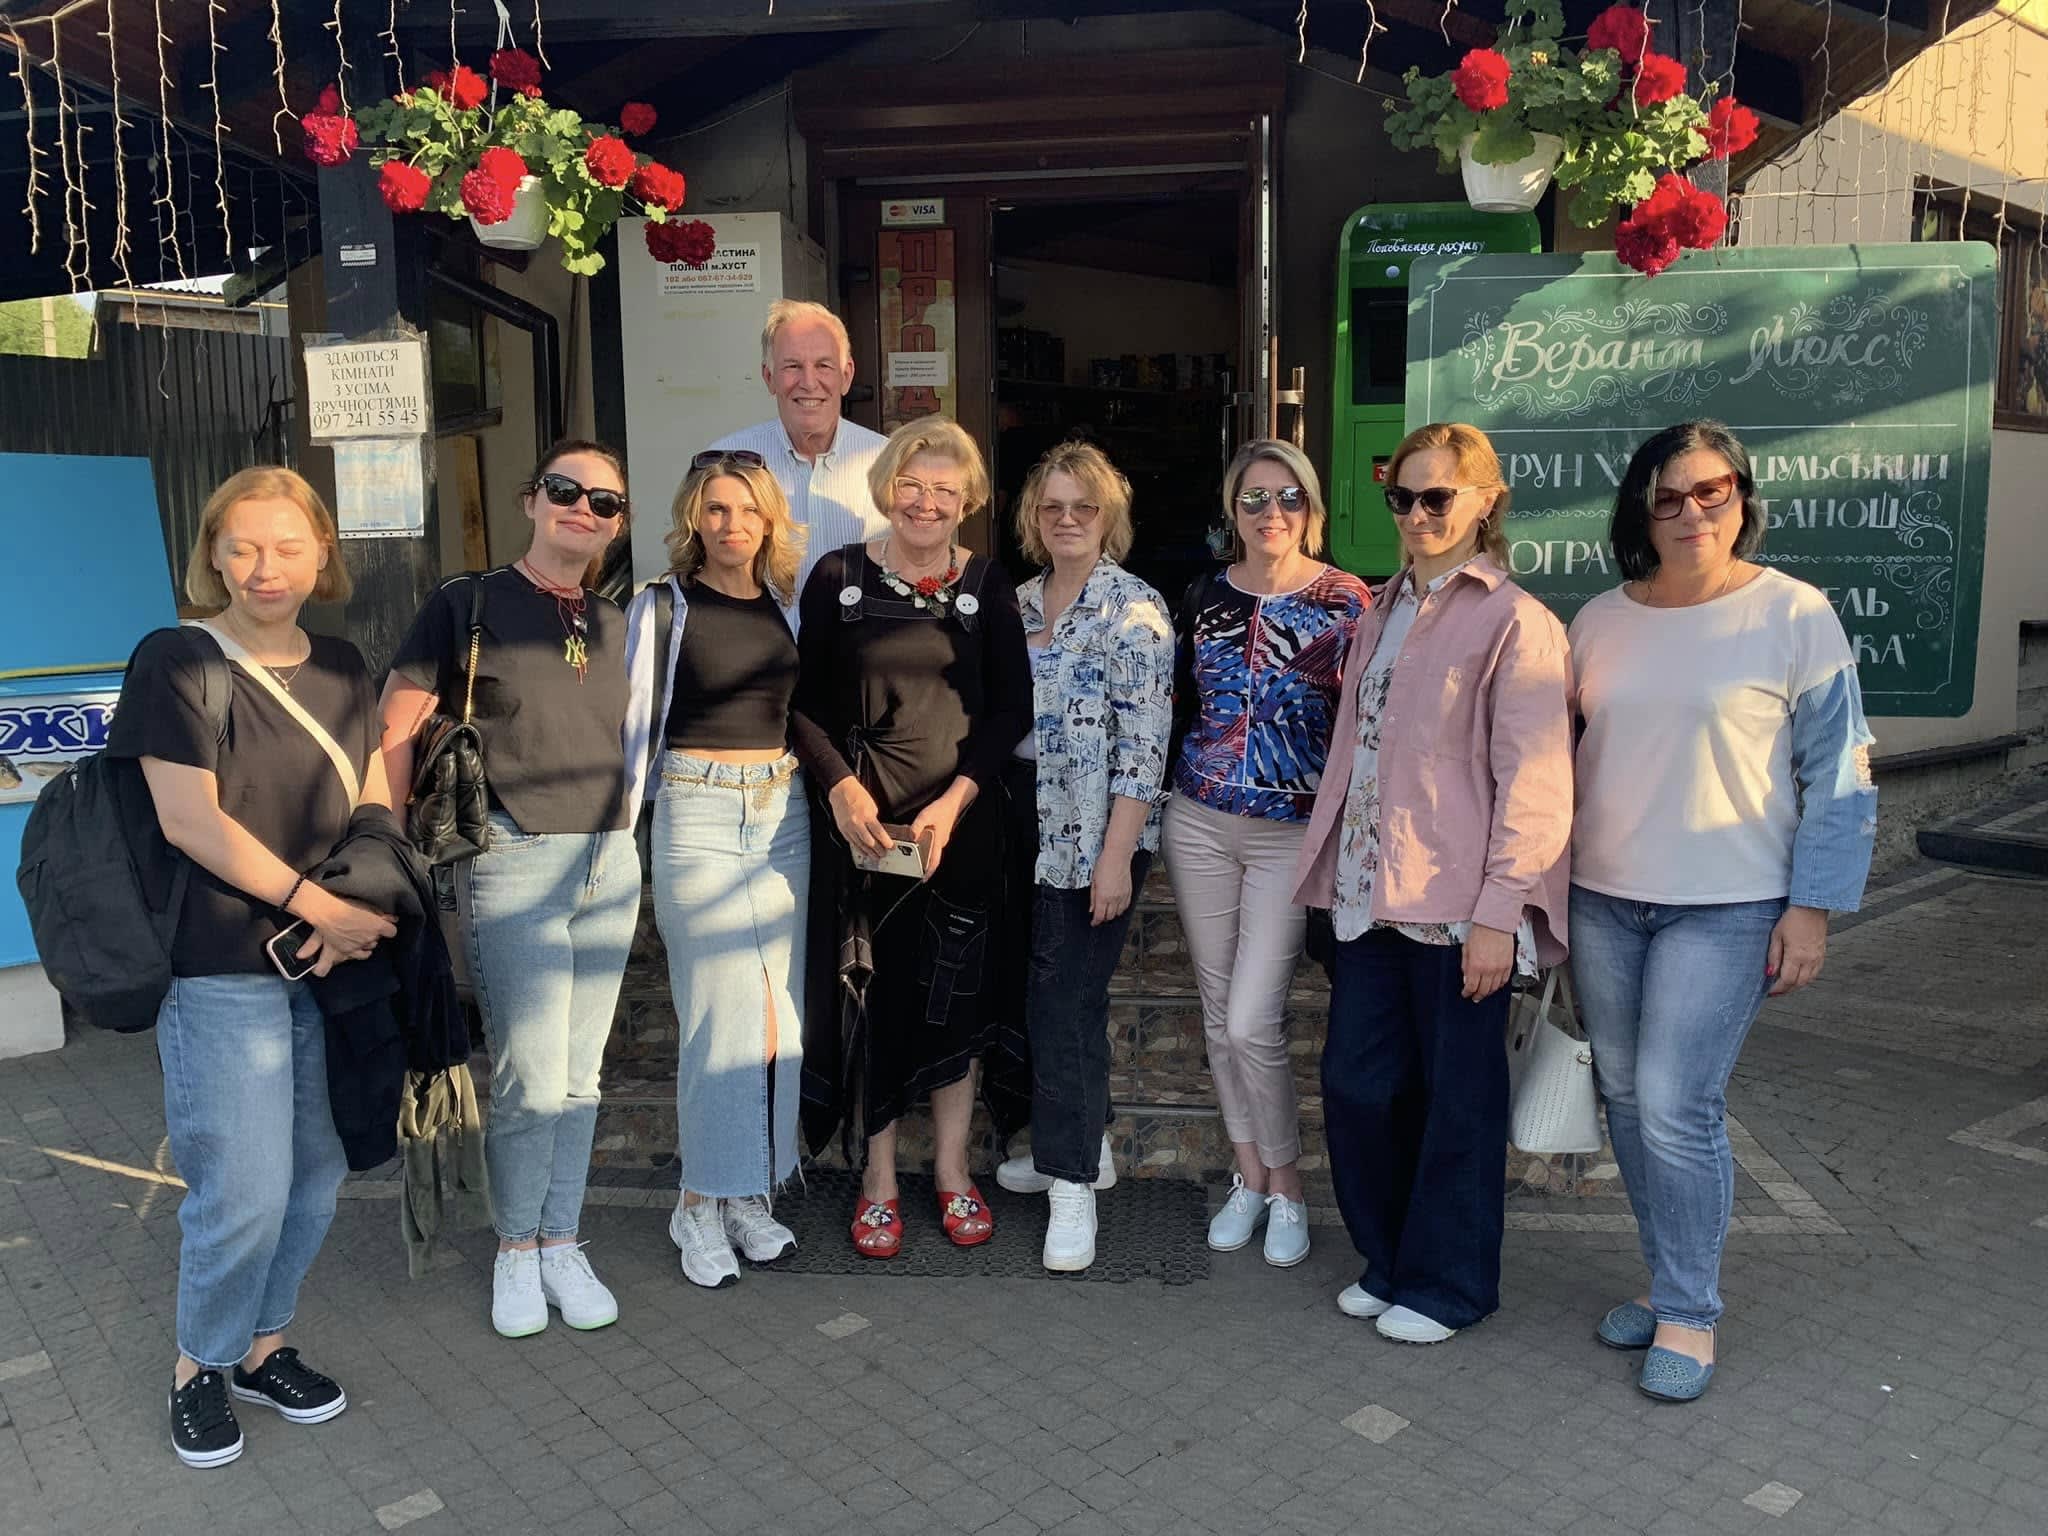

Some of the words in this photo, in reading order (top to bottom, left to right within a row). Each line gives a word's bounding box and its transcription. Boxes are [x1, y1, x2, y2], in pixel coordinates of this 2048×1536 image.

[912, 205, 936, 215] VISA
[325, 348, 400, 366] ЗДАЮТЬСЯ
[1491, 320, 1716, 392] Веранда
[1730, 314, 1890, 385] Люкс
[331, 365, 395, 380] КІМНАТИ
[345, 382, 391, 396] УСІМА
[314, 396, 418, 413] ЗРУЧНОСТЯМИ
[313, 413, 341, 430] 097
[347, 411, 371, 428] 241
[378, 410, 396, 426] 55
[399, 409, 419, 424] 45
[1497, 453, 1584, 489] РУН
[1748, 453, 1949, 488] ЦУЛЬСЬКИЙ
[1761, 491, 1899, 529] БАНОШ
[1508, 540, 1616, 575] ОГРА
